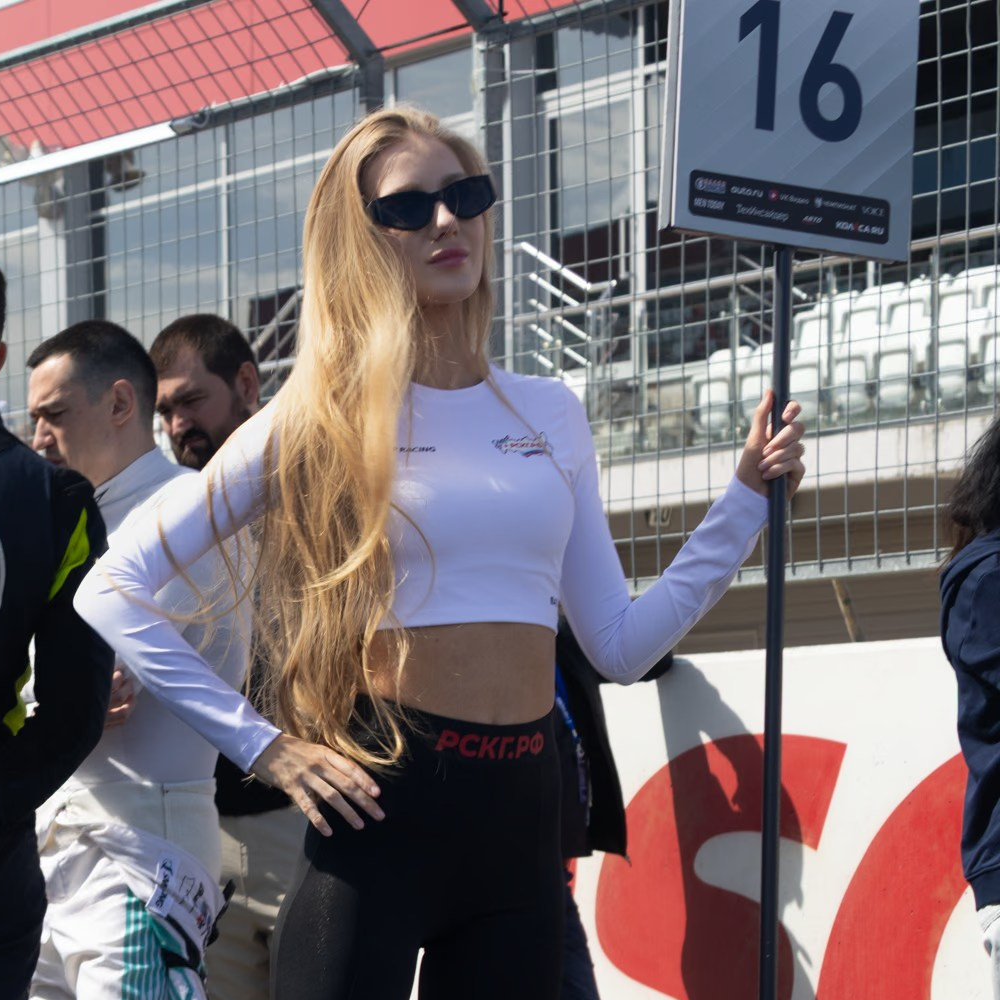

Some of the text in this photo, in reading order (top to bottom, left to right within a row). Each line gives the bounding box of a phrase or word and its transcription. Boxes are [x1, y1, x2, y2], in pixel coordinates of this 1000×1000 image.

[738, 0, 863, 142] 16
[730, 185, 764, 198] auto.ru
[434, 728, 545, 760] РСКГ.РФ
